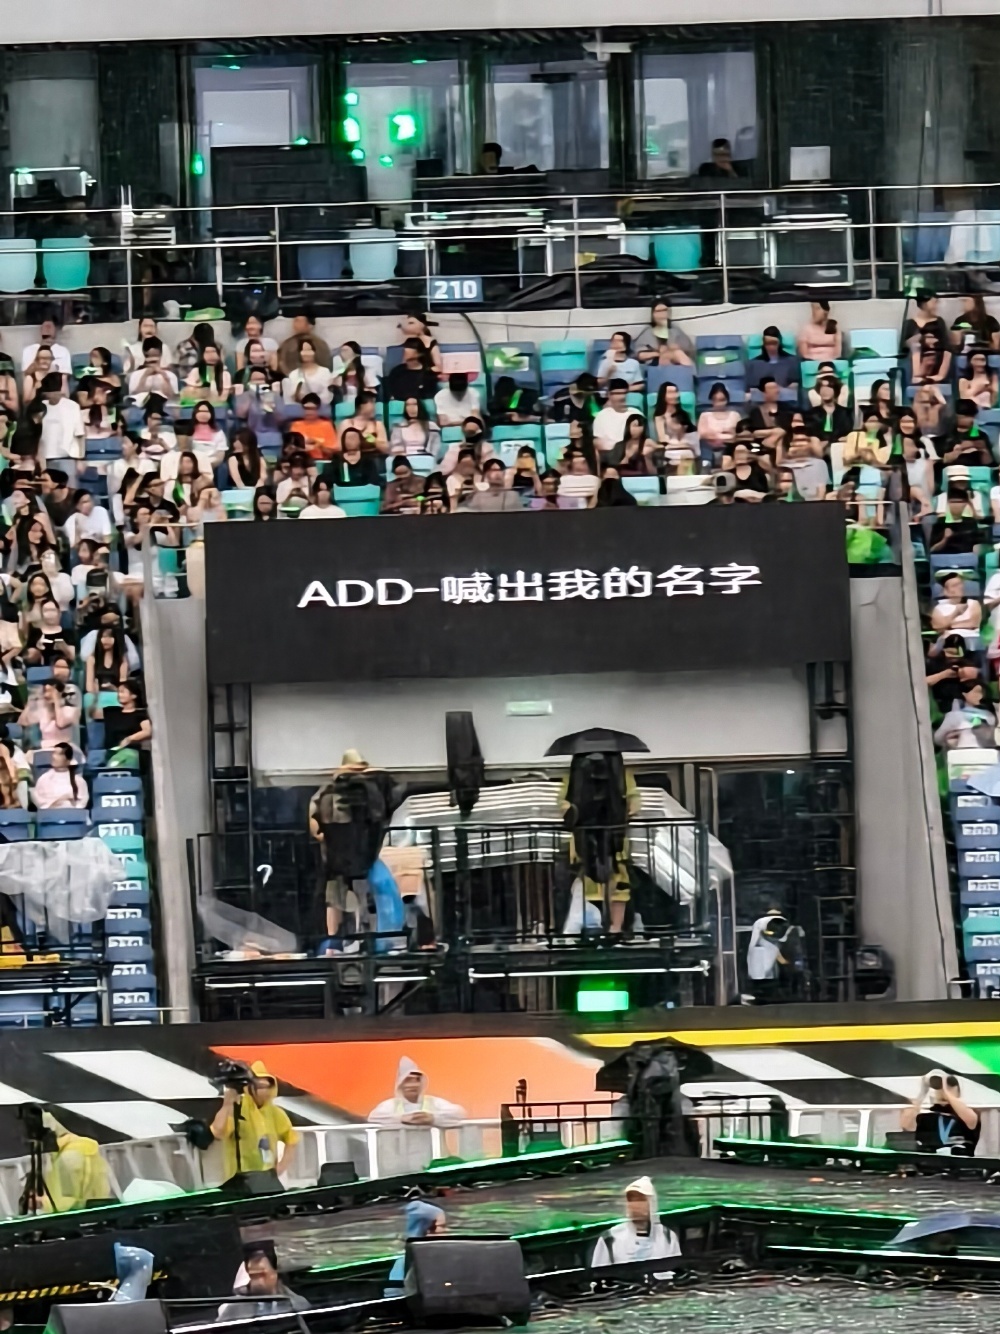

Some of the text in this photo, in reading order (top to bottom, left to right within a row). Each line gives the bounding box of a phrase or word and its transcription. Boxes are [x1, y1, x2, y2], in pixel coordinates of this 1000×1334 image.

[434, 280, 478, 300] 210
[297, 562, 763, 608] ADD-喊出我的名字
